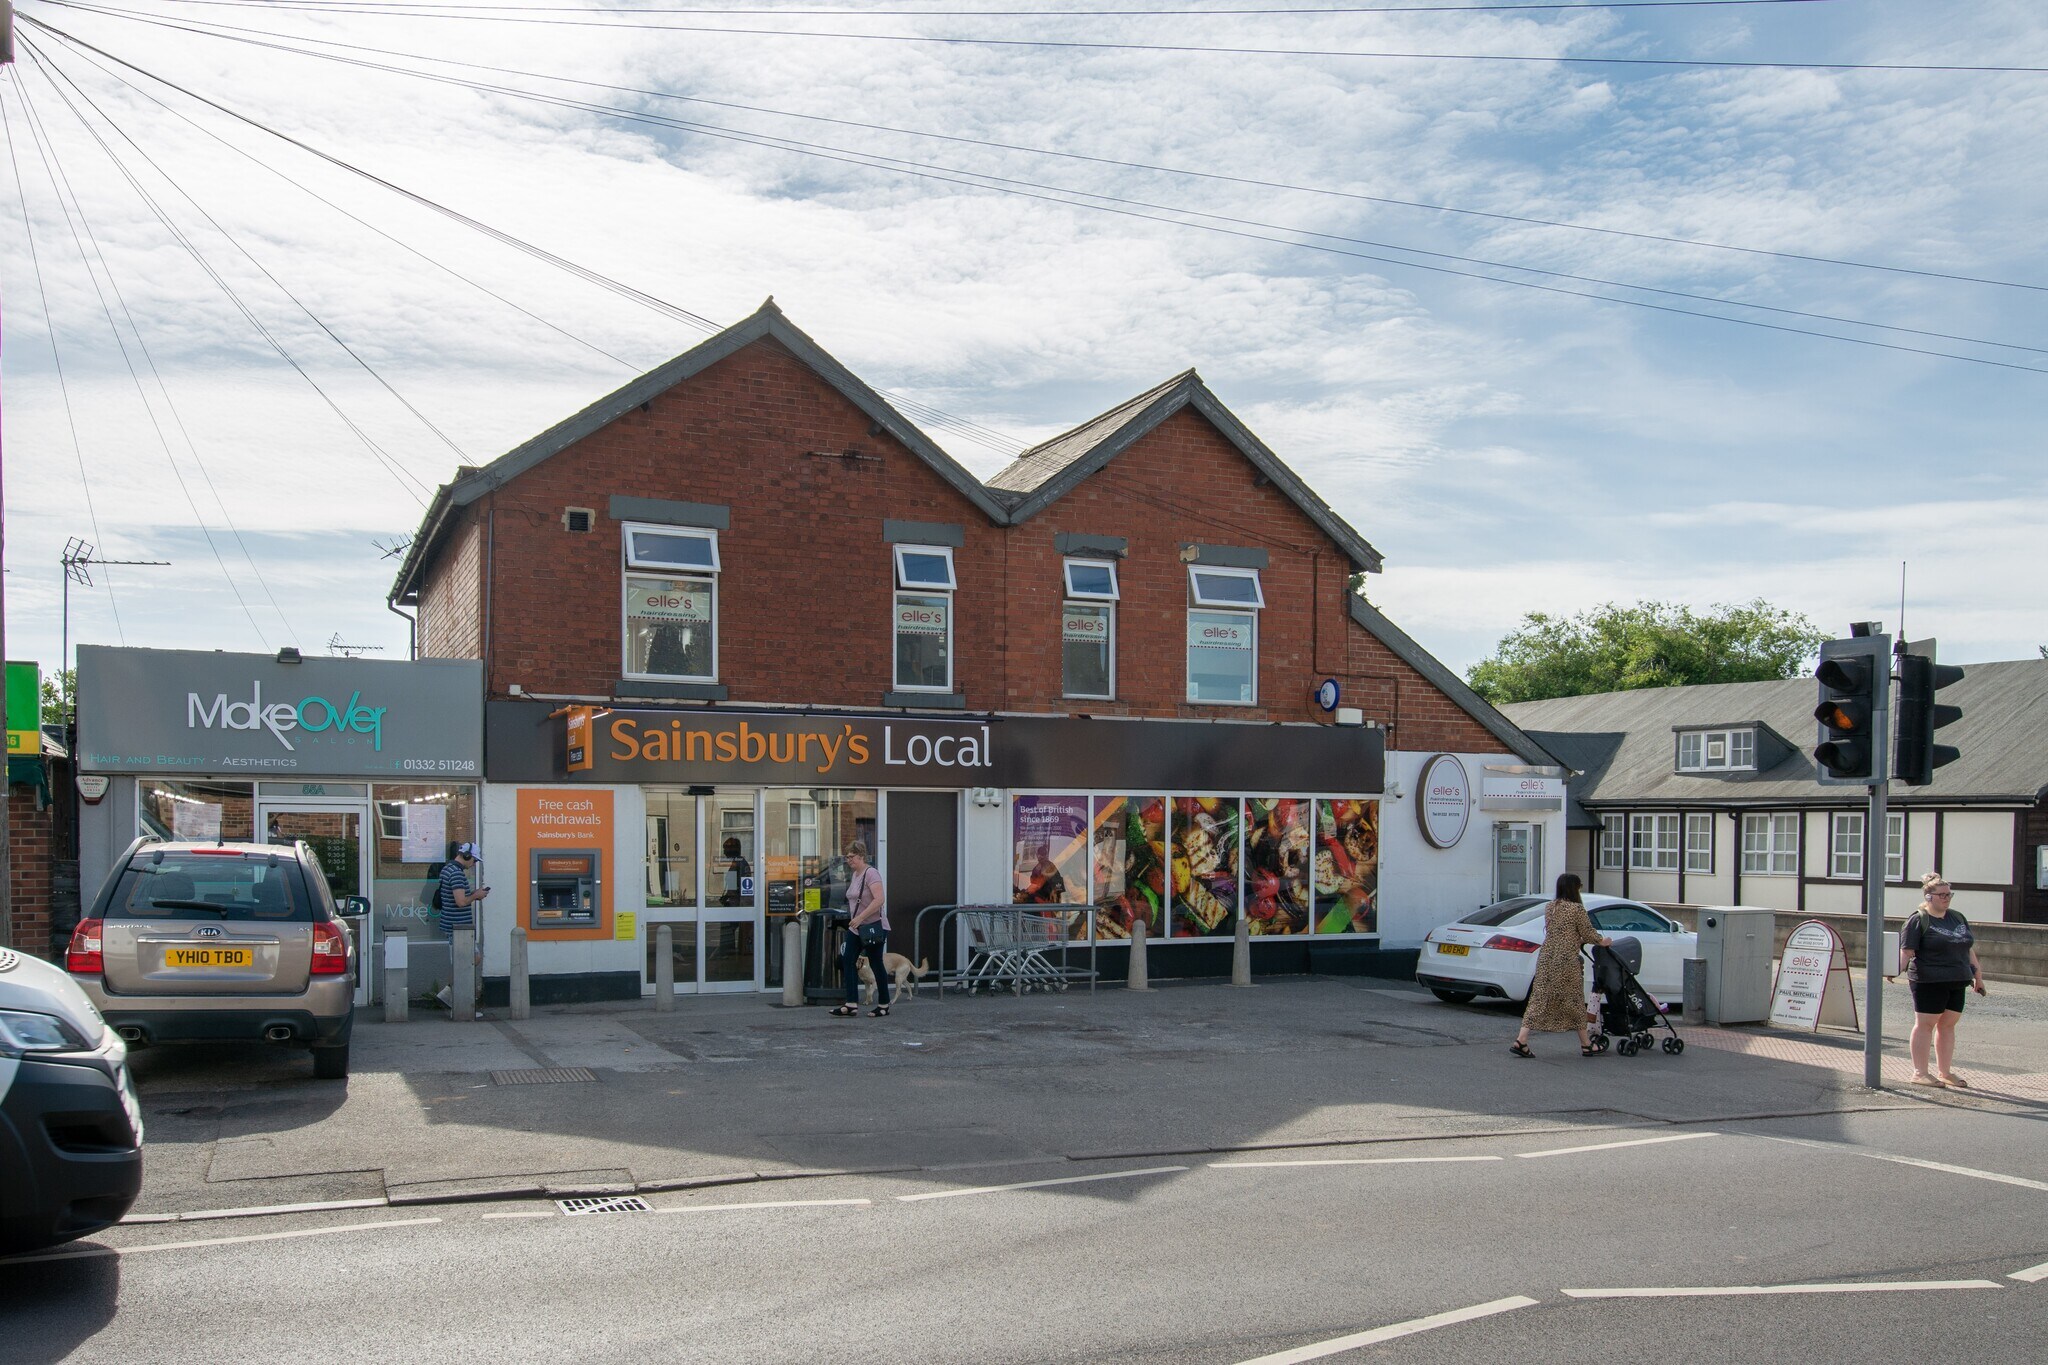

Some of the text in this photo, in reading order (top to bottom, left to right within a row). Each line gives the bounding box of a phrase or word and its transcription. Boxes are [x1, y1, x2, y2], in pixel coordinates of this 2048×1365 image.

[647, 595, 692, 609] elle's
[640, 610, 697, 618] hairdressing
[902, 610, 941, 623] elle's
[1067, 618, 1104, 632] elle's
[1204, 627, 1238, 639] elle's
[295, 736, 373, 745] SALON
[610, 718, 993, 773] Sainsbury's Local
[222, 756, 297, 767] AESTHETICS
[404, 759, 435, 770] 01332
[438, 760, 475, 771] 511248
[1520, 779, 1544, 790] elle's
[1433, 786, 1460, 796] elle's
[538, 799, 593, 810] Free cash
[1049, 806, 1073, 814] British
[530, 813, 601, 825] withdrawals
[1020, 815, 1059, 823] since 1869
[537, 831, 595, 840] Sainsbury's Bank
[1501, 844, 1525, 854] elle's
[200, 928, 218, 936] KIA
[176, 951, 243, 964] YH10 TBO
[1793, 956, 1819, 968] elle's
